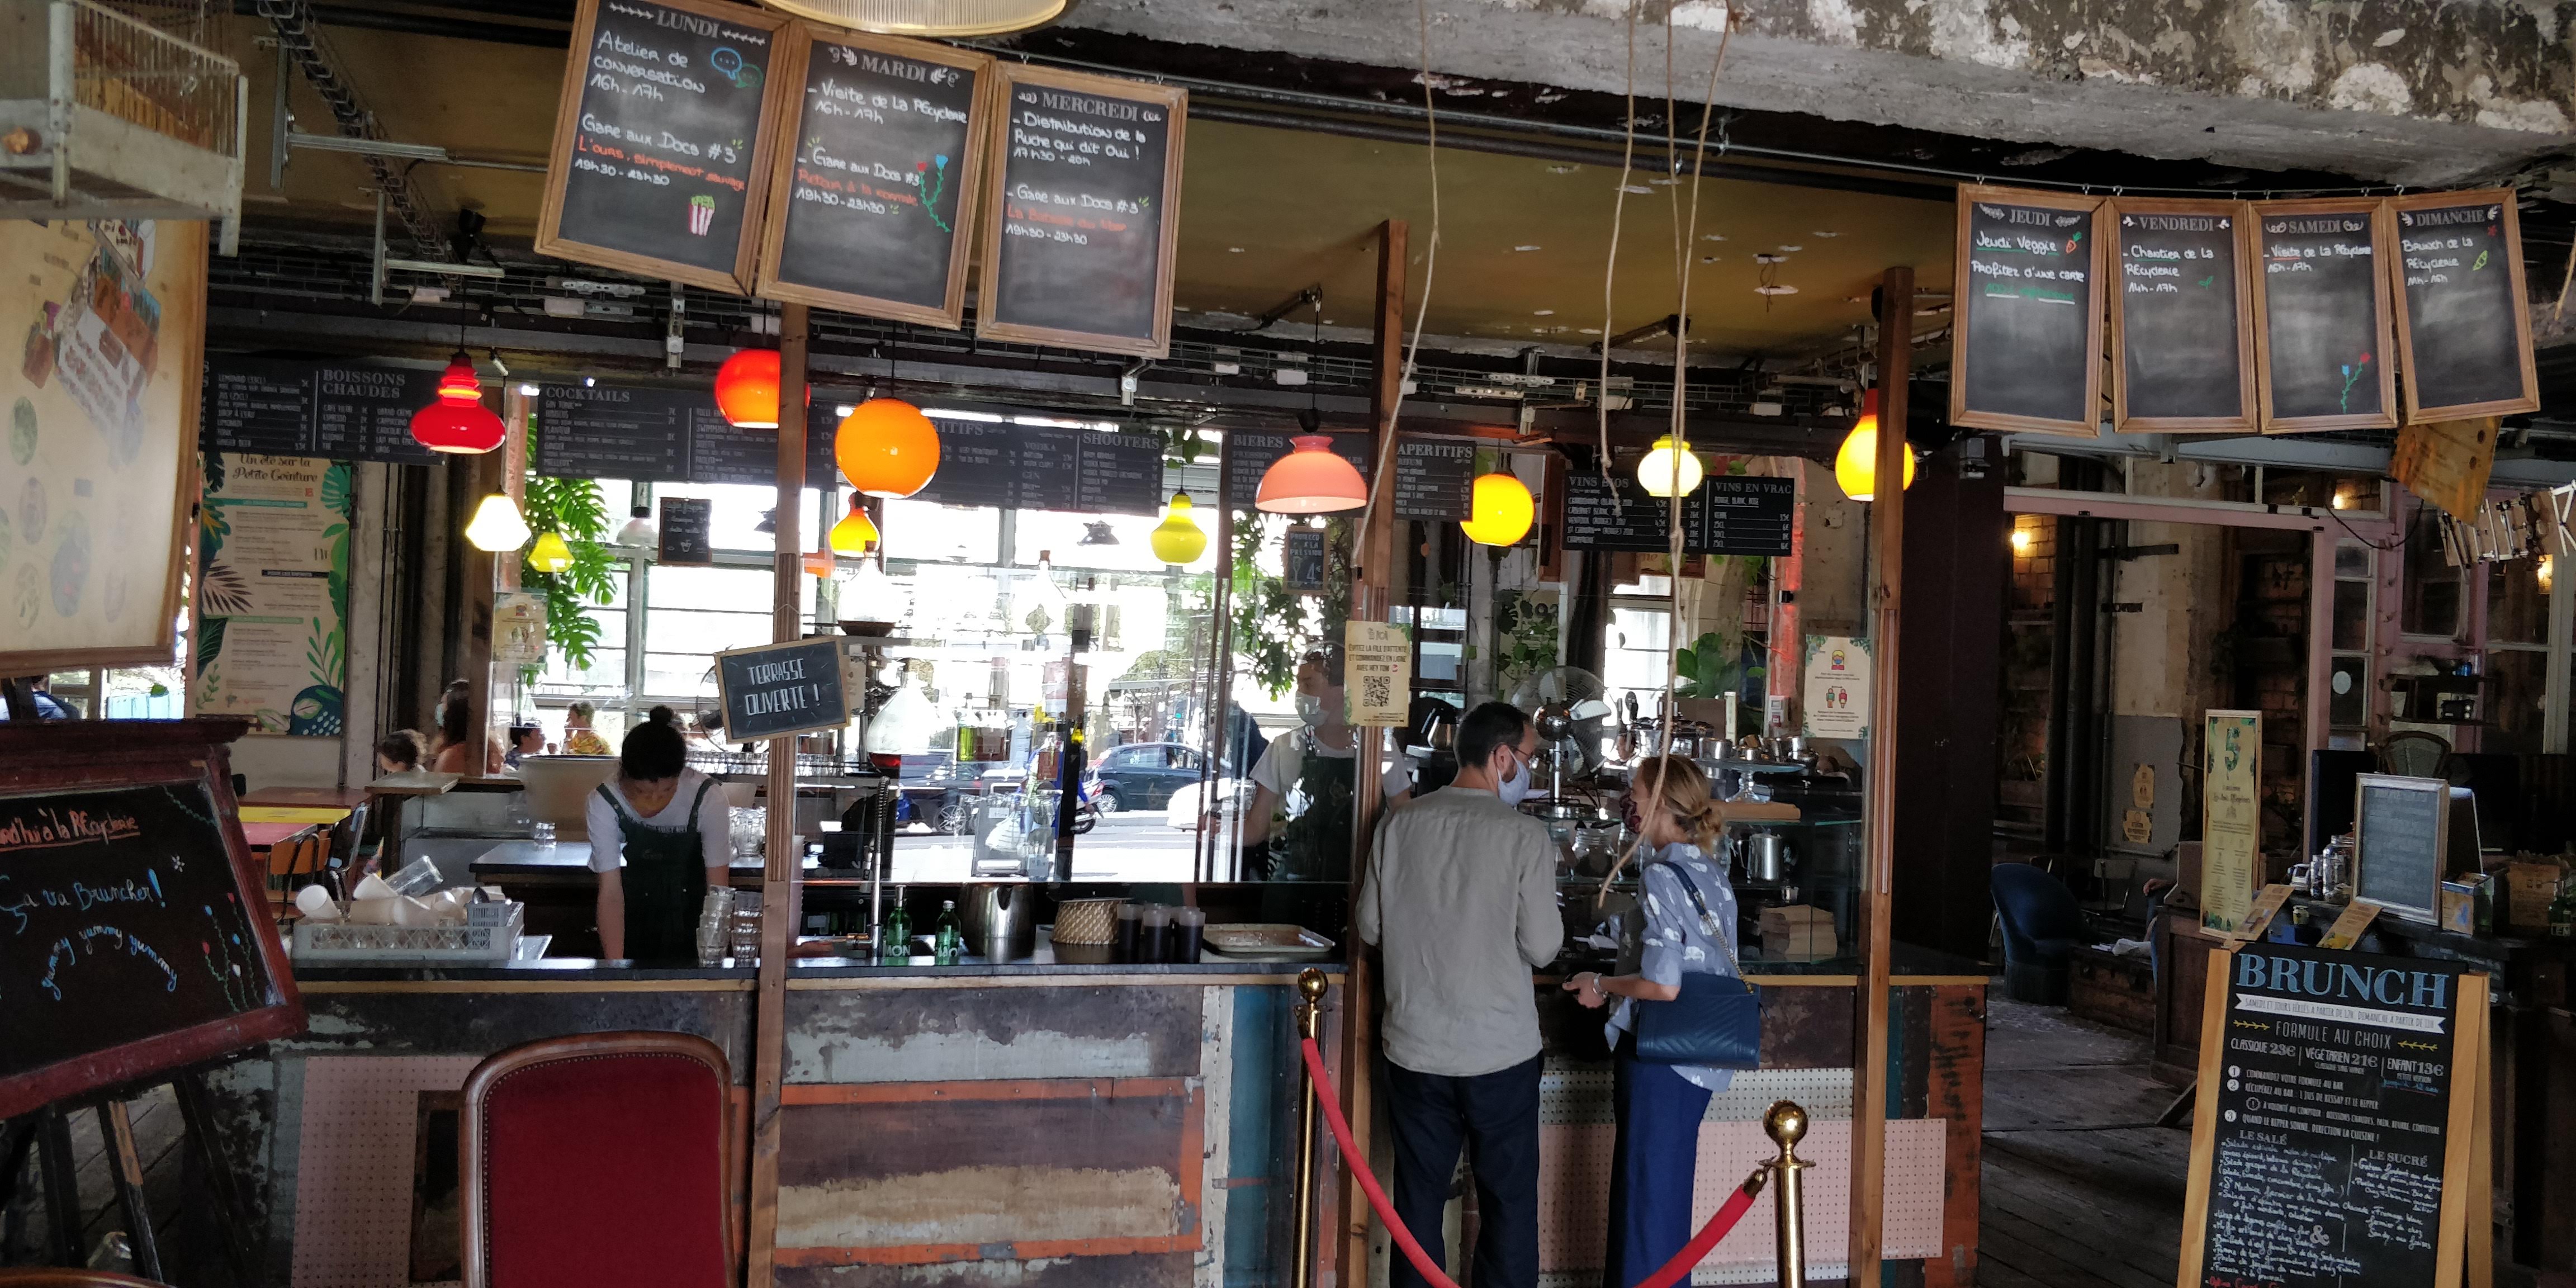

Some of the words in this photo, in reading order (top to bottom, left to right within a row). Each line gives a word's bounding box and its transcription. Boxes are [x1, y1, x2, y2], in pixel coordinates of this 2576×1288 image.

[656, 10, 719, 38] LUNDI
[597, 31, 659, 61] Atelier
[669, 51, 688, 68] de
[594, 55, 705, 93] conversation
[861, 55, 926, 82] MARDI
[822, 79, 866, 105] Visite
[872, 96, 888, 109] de
[1043, 92, 1138, 121] MERCREDI
[583, 113, 621, 139] Gare
[626, 131, 652, 146] aux
[657, 131, 700, 156] Docs
[1024, 112, 1112, 139] Distribution
[1115, 129, 1131, 141] de
[1015, 129, 1050, 148] Ruche
[1054, 140, 1074, 154] qui
[1079, 142, 1100, 154] dit
[812, 146, 846, 171] Gare
[851, 162, 869, 175] aux
[874, 163, 901, 182] Docs
[1017, 184, 1049, 203] Gare
[1054, 195, 1076, 206] aux
[1081, 193, 1113, 210] Docs
[2009, 209, 2051, 226] JEUDI
[2139, 217, 2214, 231] VENDREDI
[2289, 220, 2341, 234] SAMEDI
[2416, 210, 2485, 226] DIMANCHE
[1976, 230, 2012, 249] Jeudi
[2016, 235, 2057, 255] Veggie
[2131, 245, 2181, 259] Chantier
[2184, 249, 2196, 259] de
[2271, 244, 2300, 257] Visite
[2304, 248, 2315, 257] de
[2402, 240, 2444, 252] Brunch
[2447, 240, 2459, 249] de
[1971, 260, 2019, 278] Profitez
[2024, 266, 2056, 280] d'une
[2059, 271, 2085, 282] carte
[323, 370, 405, 386] BOISSONS
[323, 383, 400, 398] CHAUDES
[546, 387, 630, 402] COCKTAILS
[1083, 433, 1159, 449] SHOOTERS
[233, 467, 268, 480] Petite
[271, 469, 318, 482] Ceinture
[1569, 476, 1597, 487] VINS
[1716, 482, 1741, 492] VINS
[1745, 484, 1759, 493] EN
[1764, 484, 1792, 494] VRAC
[747, 658, 807, 685] TERRASSE
[745, 685, 808, 716] OUVERTE
[42, 888, 72, 907] va
[73, 879, 154, 911] Bruncher
[2236, 953, 2450, 1009] BRUNCH
[2276, 1021, 2328, 1042] FORMULE
[2333, 1027, 2349, 1045] AU
[2355, 1030, 2392, 1050] CHOIX
[2231, 1038, 2268, 1053] CLASSIQUE
[2269, 1043, 2296, 1057] 23€
[2351, 1053, 2378, 1068] 21€
[2387, 1058, 2417, 1072] ENFANT
[2417, 1062, 2445, 1076] 13€
[2239, 1129, 2255, 1140] LE
[2257, 1131, 2288, 1145] SALÉ
[2369, 1149, 2385, 1161] LE
[2386, 1152, 2428, 1167] SUCRÉ
[2309, 1225, 2329, 1246] &
